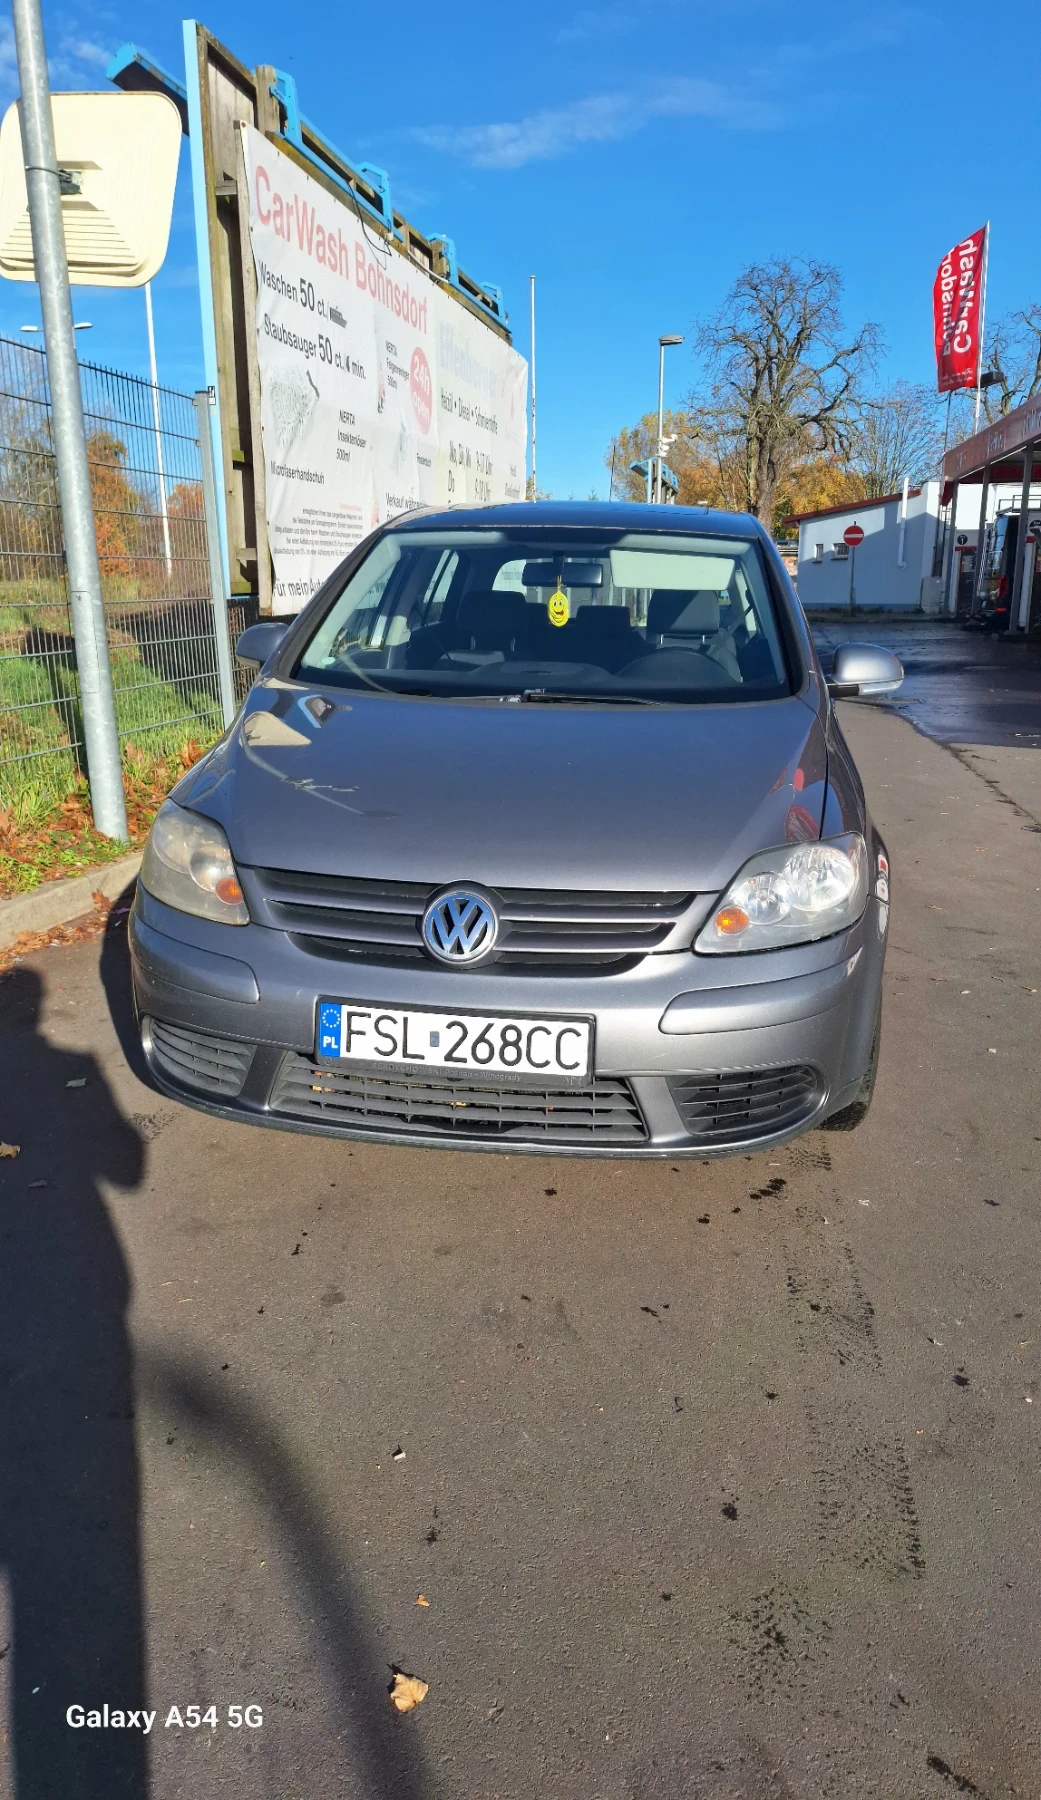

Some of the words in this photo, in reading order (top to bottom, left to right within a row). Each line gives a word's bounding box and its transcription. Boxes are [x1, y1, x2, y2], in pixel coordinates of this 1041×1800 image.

[256, 165, 349, 280] CarWash
[354, 241, 428, 335] Bohnsdorf
[259, 259, 299, 303] Waschen
[300, 277, 315, 311] 50
[264, 312, 317, 360] Staubsauger
[318, 333, 333, 365] 50
[413, 355, 430, 396] 24h
[339, 409, 356, 426] NERTA
[336, 448, 350, 462] 500ml
[385, 492, 404, 508] Verkauf
[287, 577, 309, 597] mein
[322, 1035, 339, 1050] PL
[345, 1010, 425, 1061] FSL
[443, 1020, 582, 1070] 268CC
